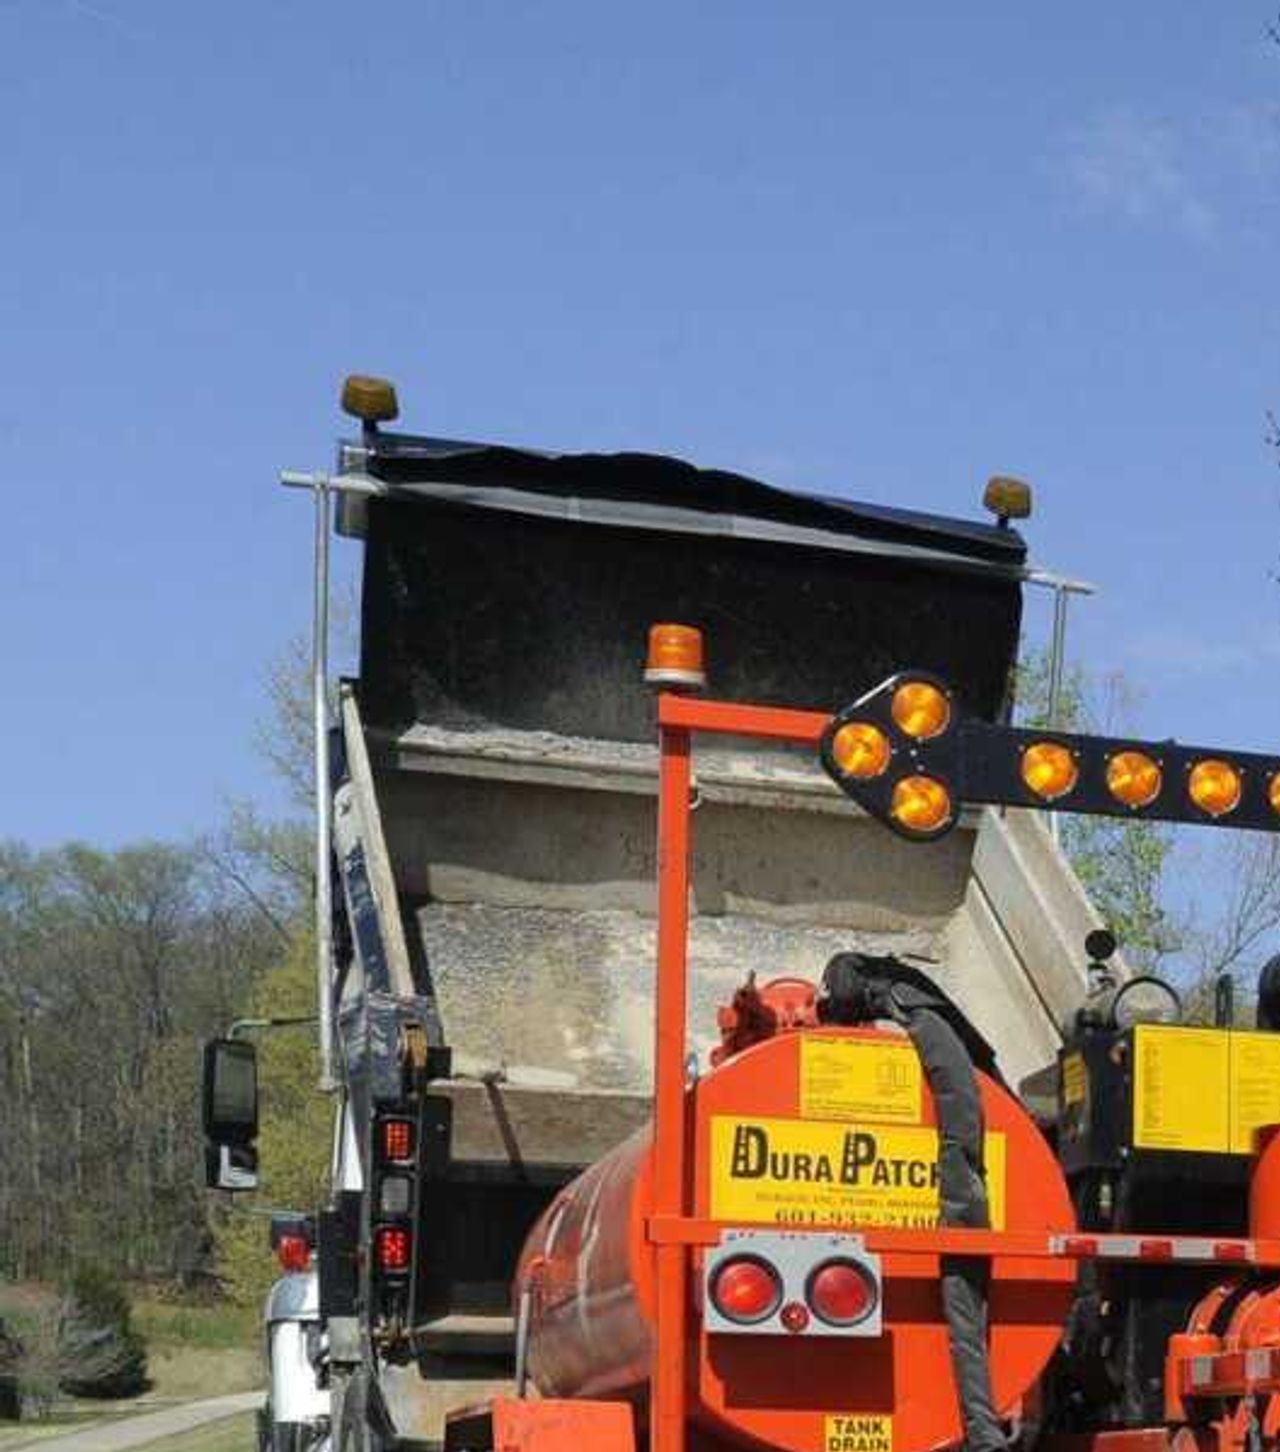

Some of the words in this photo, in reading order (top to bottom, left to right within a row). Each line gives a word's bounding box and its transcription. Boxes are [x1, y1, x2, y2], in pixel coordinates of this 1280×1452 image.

[730, 1124, 834, 1183] DURA
[833, 1418, 886, 1436] TANK
[828, 1436, 889, 1452] DRAIN
